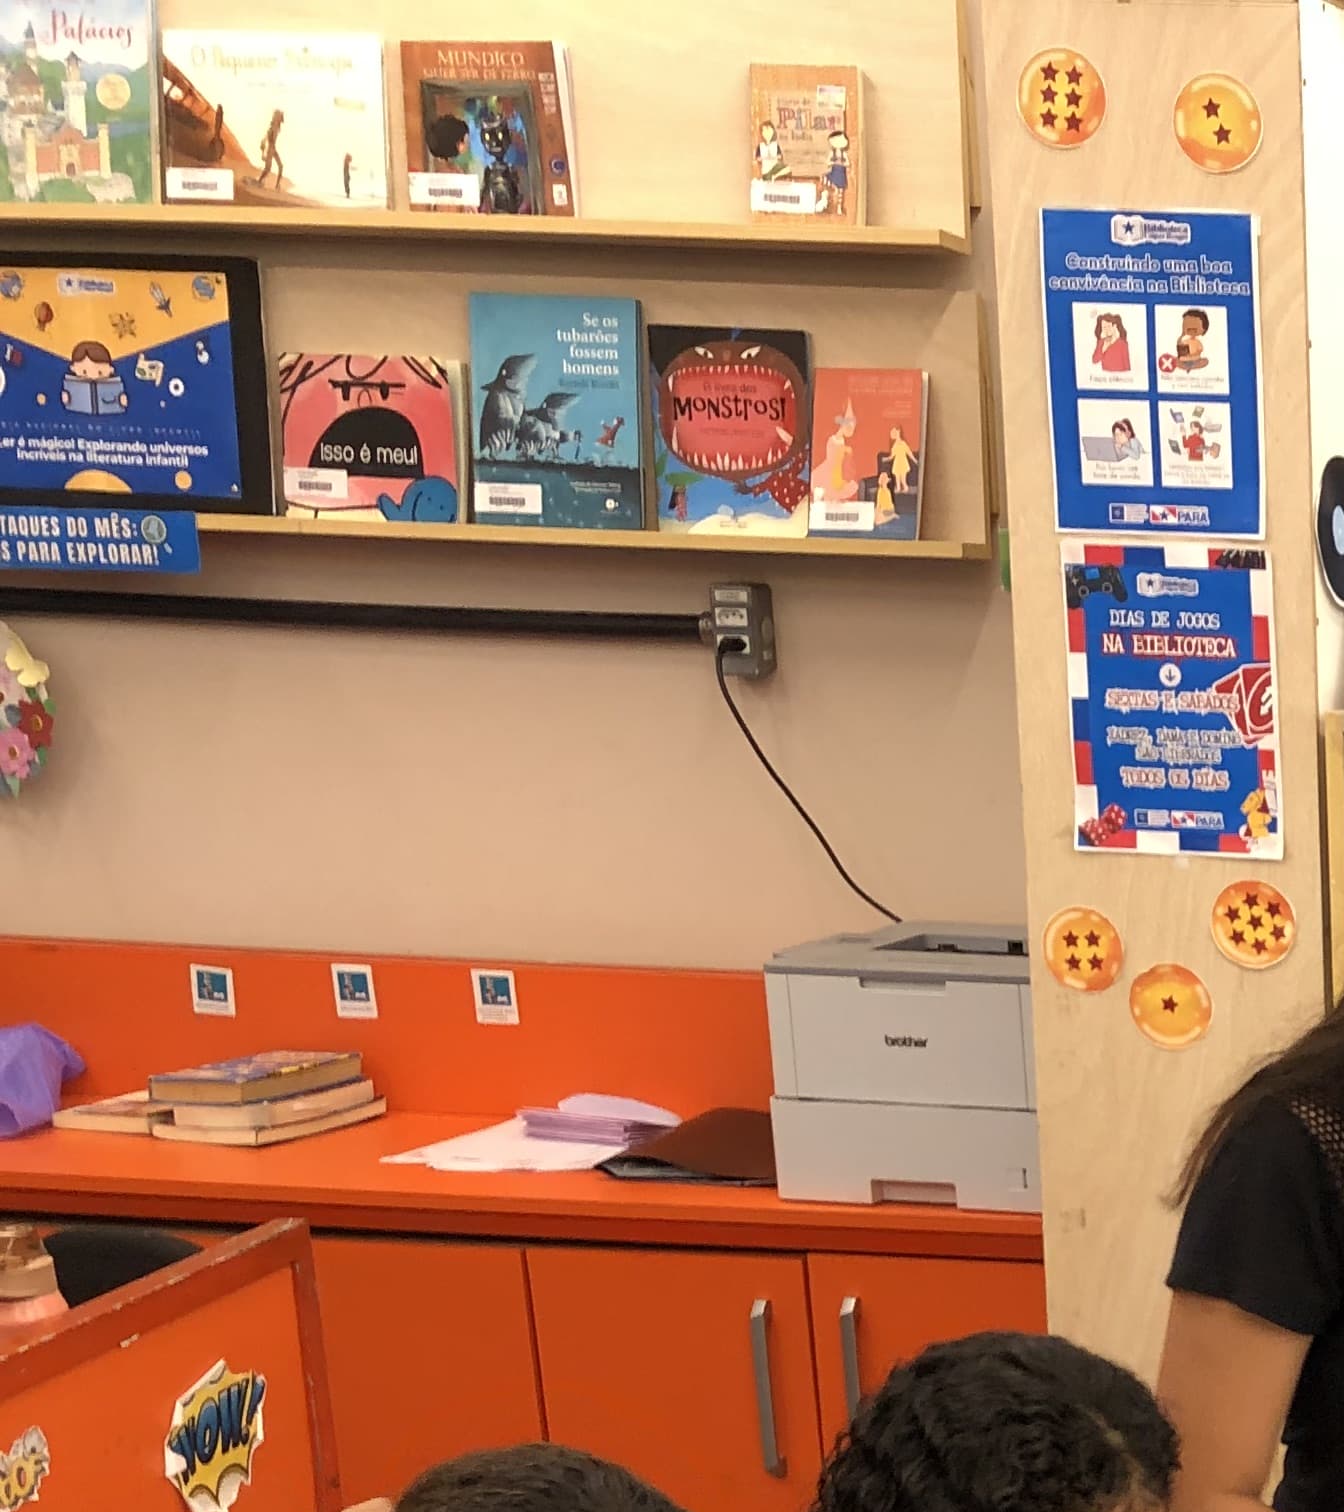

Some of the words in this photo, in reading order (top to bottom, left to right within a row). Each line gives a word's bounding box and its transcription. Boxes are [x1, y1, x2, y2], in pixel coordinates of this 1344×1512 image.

[437, 50, 525, 67] MUNDICO
[1065, 252, 1160, 272] Construindo
[1163, 258, 1198, 274] uma
[1200, 254, 1232, 275] boa
[1048, 273, 1144, 293] convivência
[1146, 278, 1168, 294] na
[1171, 276, 1250, 297] Biblioteca
[582, 311, 600, 328] Se
[602, 314, 619, 329] os
[555, 327, 619, 345] tubarões
[568, 343, 619, 360] fossem
[561, 358, 620, 377] homens
[18, 434, 26, 448] é
[28, 435, 76, 452] mágico!
[77, 437, 147, 454] Explorando
[150, 441, 209, 457] universos
[319, 441, 355, 463] Isso
[359, 441, 372, 463] é
[375, 443, 418, 466] meu!
[16, 447, 67, 461] incríveis
[68, 451, 84, 463] na
[85, 450, 143, 465] literatura
[145, 453, 189, 468] infantil
[66, 515, 88, 538] DO
[94, 511, 138, 540] MÊS:
[16, 540, 62, 564] PARA
[66, 541, 161, 567] EXPLORAR!
[1109, 608, 1144, 628] DIAS
[1151, 610, 1170, 629] DE
[1175, 610, 1221, 630] JOGOS
[1102, 633, 1125, 655] NA
[1132, 634, 1237, 659] BIBLIOTECA
[1106, 689, 1159, 710] SEXTAS
[1162, 690, 1175, 713] E
[1120, 766, 1166, 787] TODOS
[170, 1376, 265, 1487] WOW!
